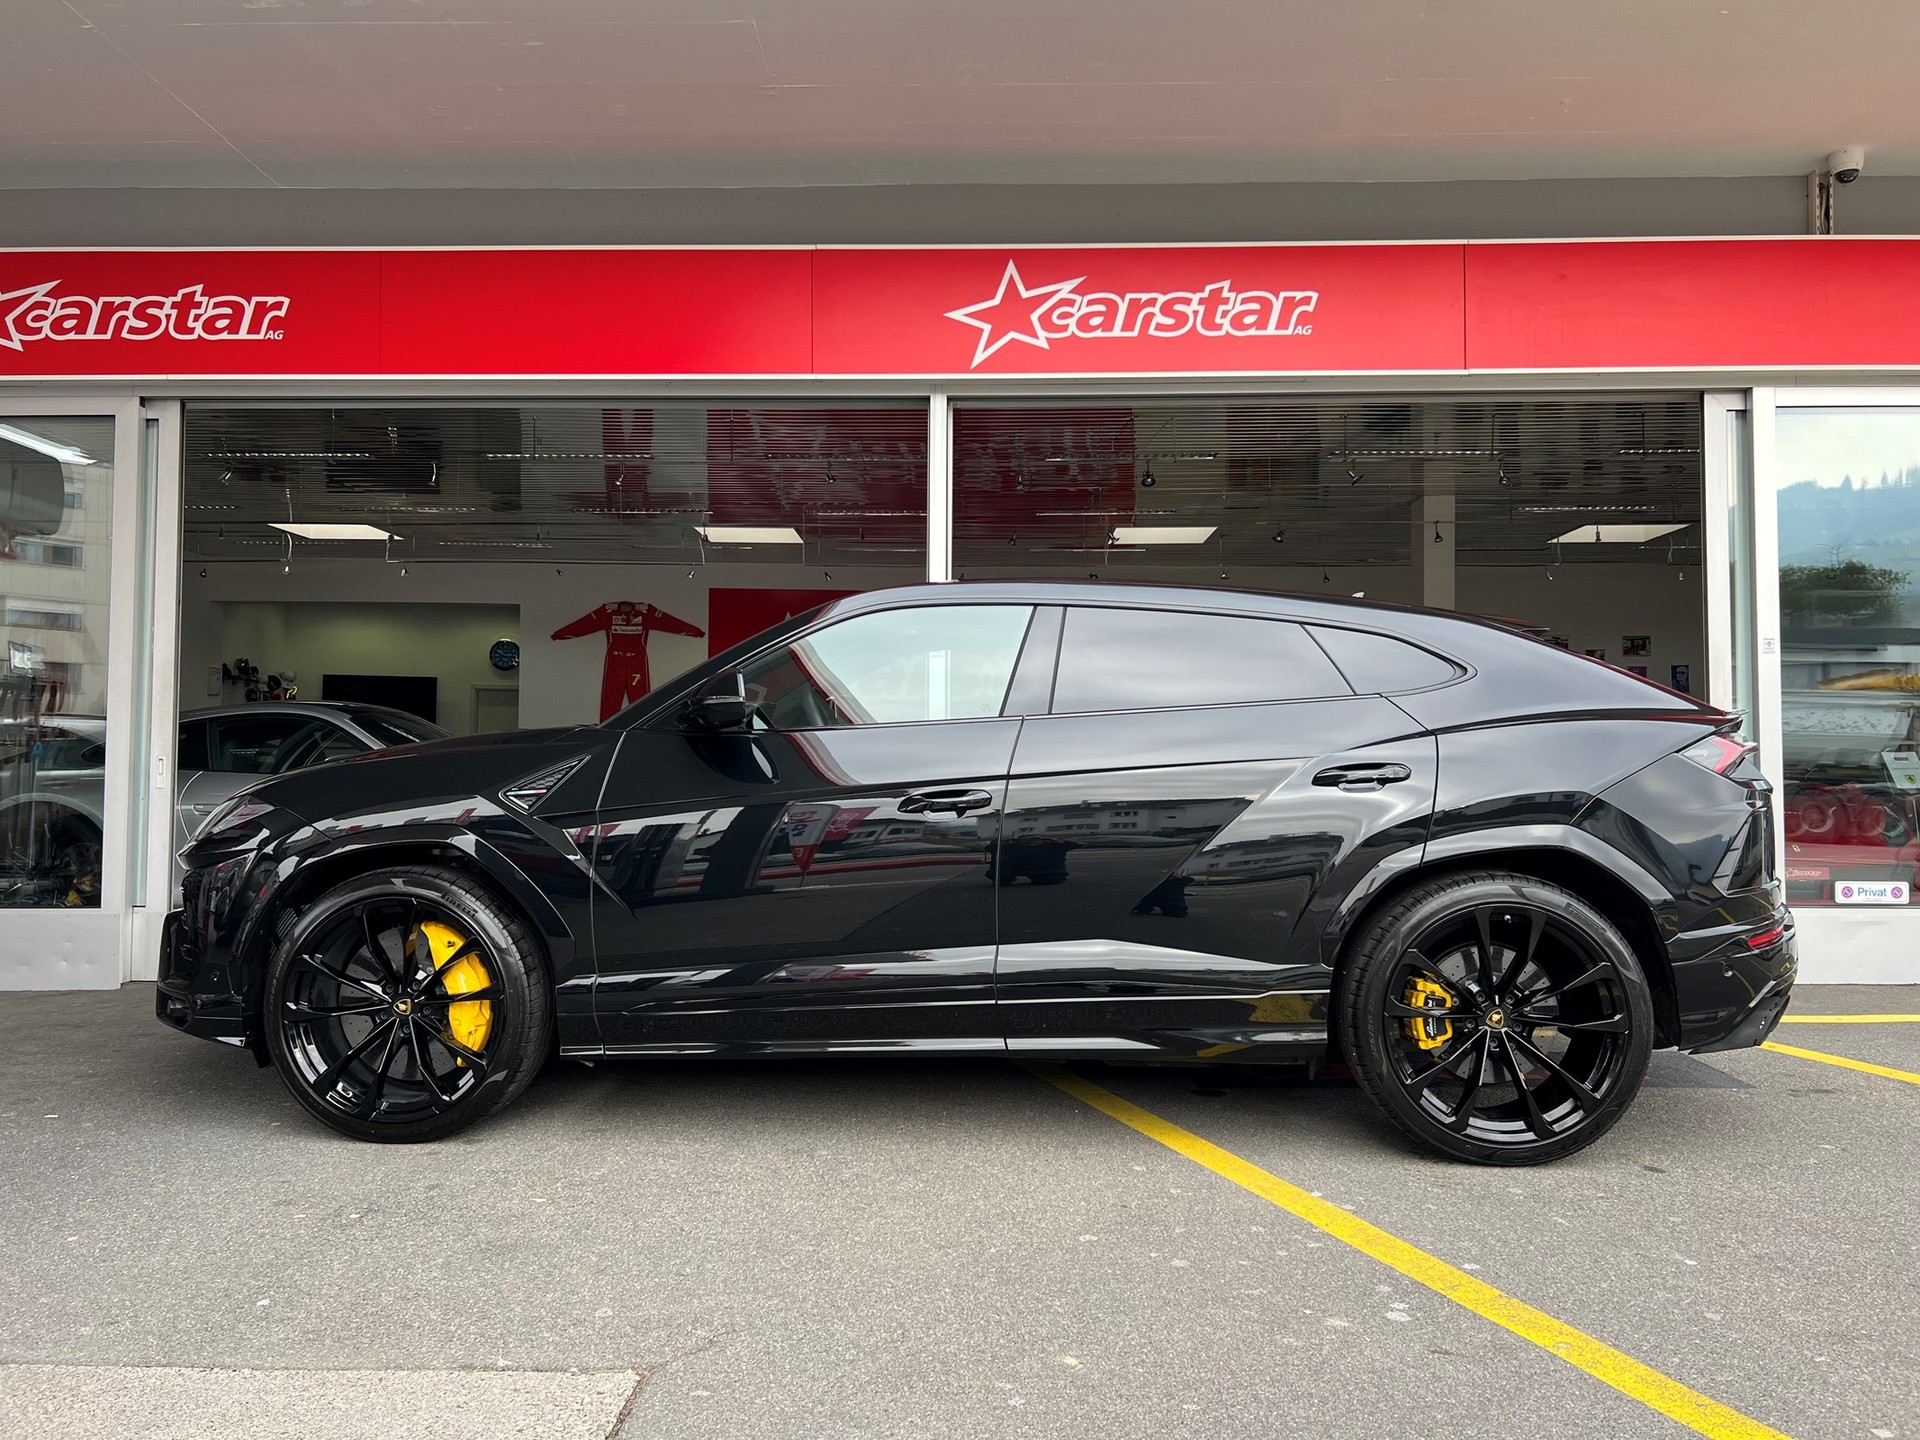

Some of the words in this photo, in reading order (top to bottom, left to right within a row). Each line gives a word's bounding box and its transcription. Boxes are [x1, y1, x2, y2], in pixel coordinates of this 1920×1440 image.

[7, 283, 291, 341] carstar
[264, 329, 285, 340] AG
[1032, 279, 1319, 338] carstar
[1293, 324, 1313, 336] AG
[632, 674, 641, 686] 7
[1857, 887, 1887, 897] Privat
